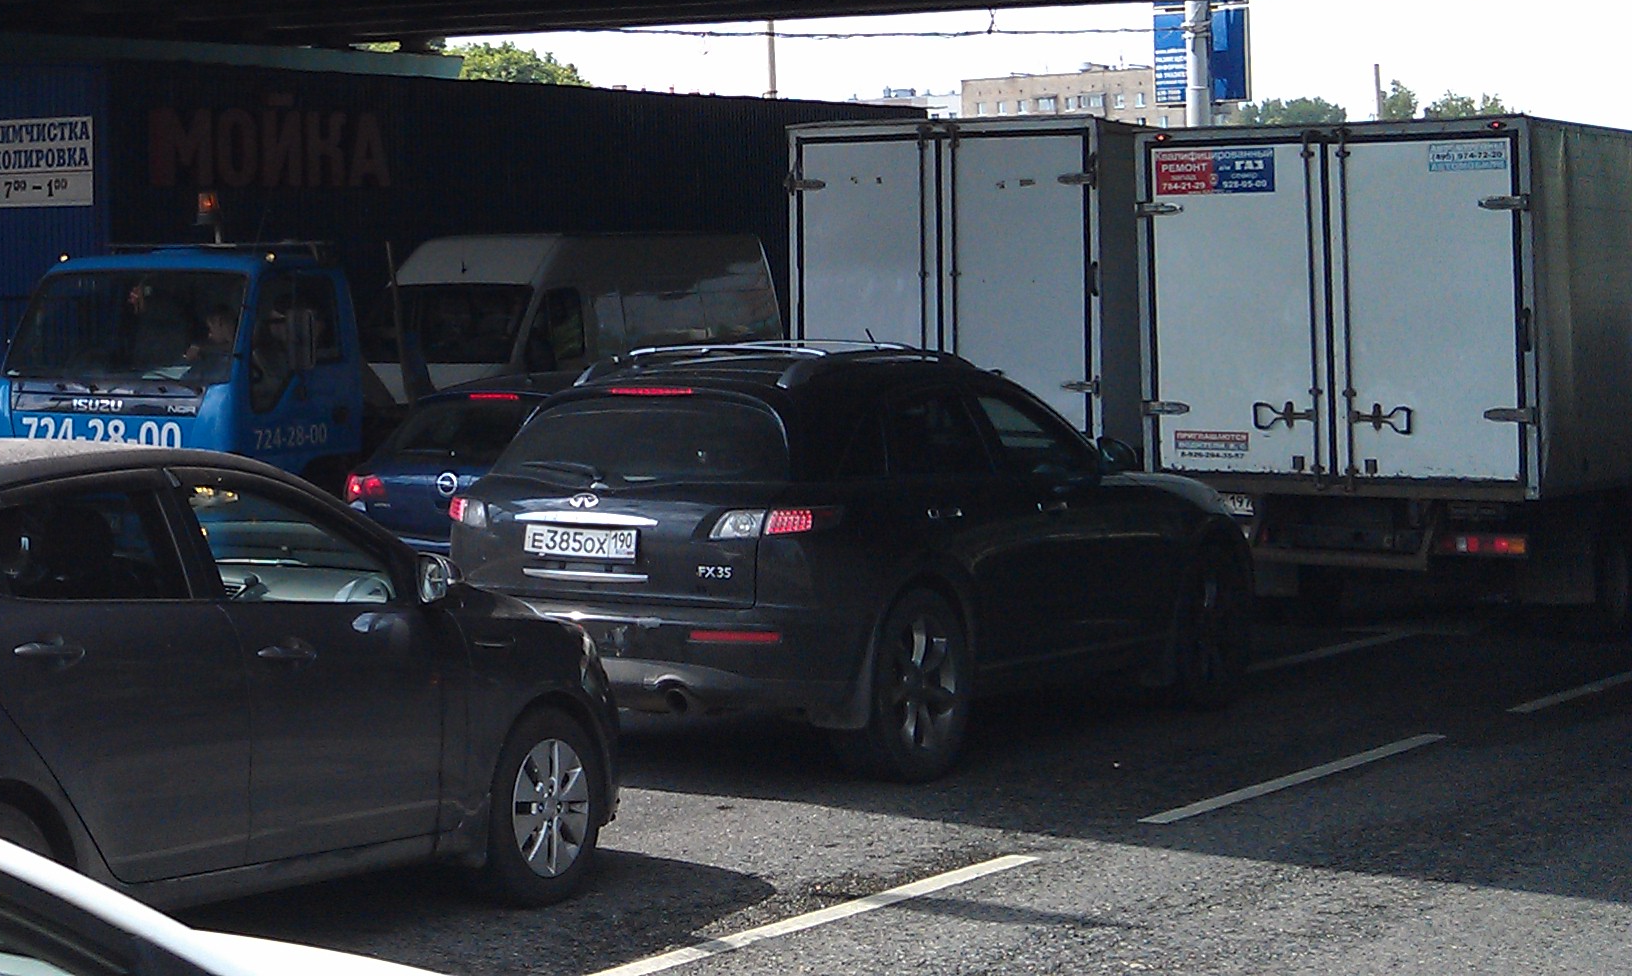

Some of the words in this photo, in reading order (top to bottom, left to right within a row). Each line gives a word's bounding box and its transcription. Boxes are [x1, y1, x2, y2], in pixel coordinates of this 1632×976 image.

[148, 93, 390, 186] МОЙКА
[1156, 148, 1274, 162] Квалифицированный
[1161, 163, 1208, 173] РЕМОНТ
[1234, 160, 1264, 170] ГАЗ
[72, 399, 123, 412] ISUZU
[21, 416, 182, 448] 724-28-00
[253, 423, 327, 450] 724-28-00
[611, 532, 633, 549] 190
